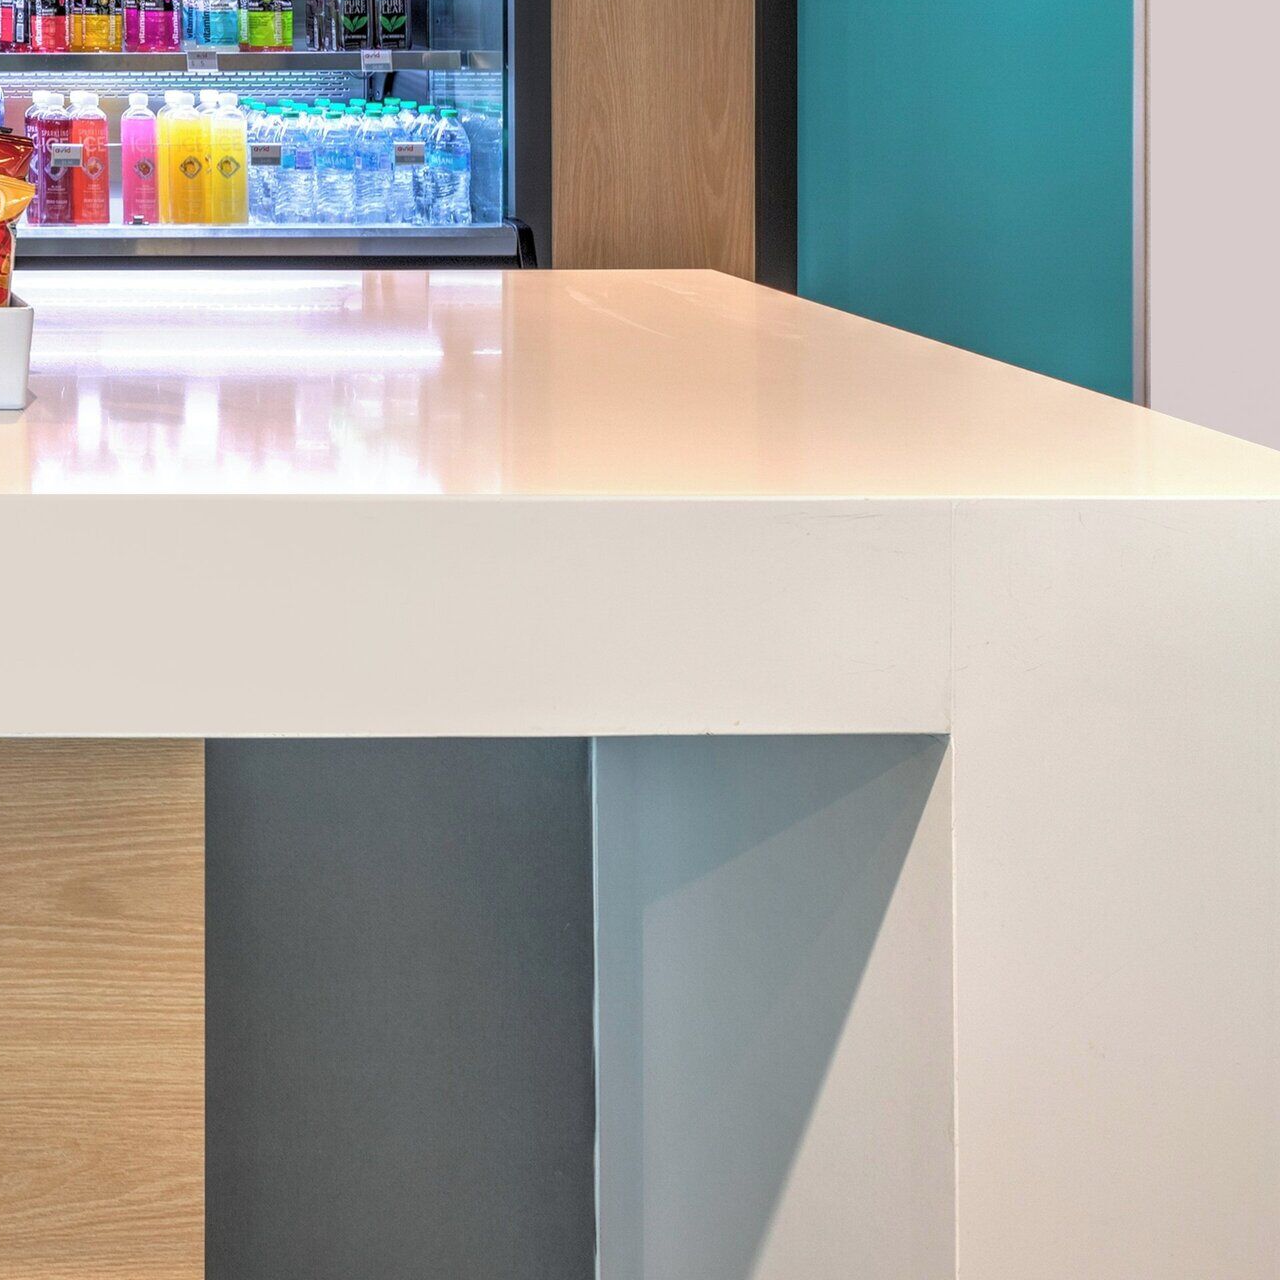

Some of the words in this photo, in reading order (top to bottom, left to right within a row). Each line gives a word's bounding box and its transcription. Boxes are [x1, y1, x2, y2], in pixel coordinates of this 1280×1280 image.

[344, 0, 366, 7] PURE
[381, 0, 404, 7] PURE
[344, 6, 366, 14] LEAF
[382, 6, 404, 14] LEAF
[80, 136, 107, 152] ICE
